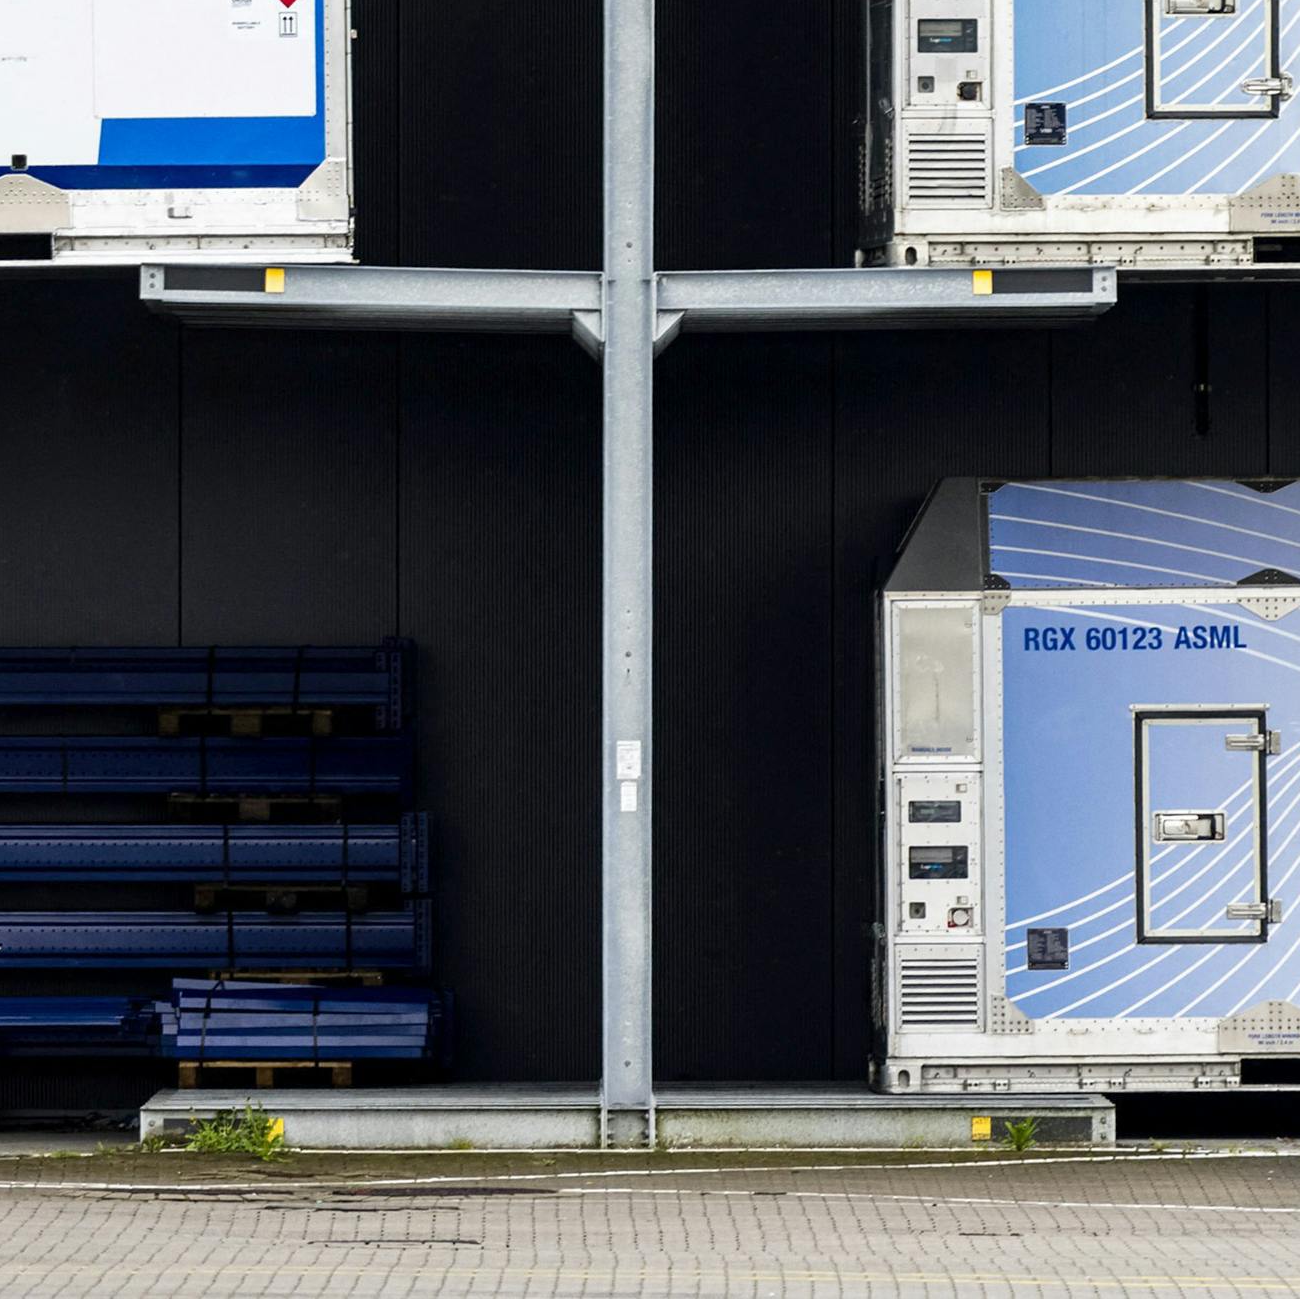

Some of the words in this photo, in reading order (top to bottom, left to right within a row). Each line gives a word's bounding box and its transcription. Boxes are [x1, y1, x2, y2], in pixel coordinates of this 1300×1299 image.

[1024, 627, 1076, 651] RGX
[1085, 626, 1163, 651] 60123
[1173, 625, 1248, 650] ASML
